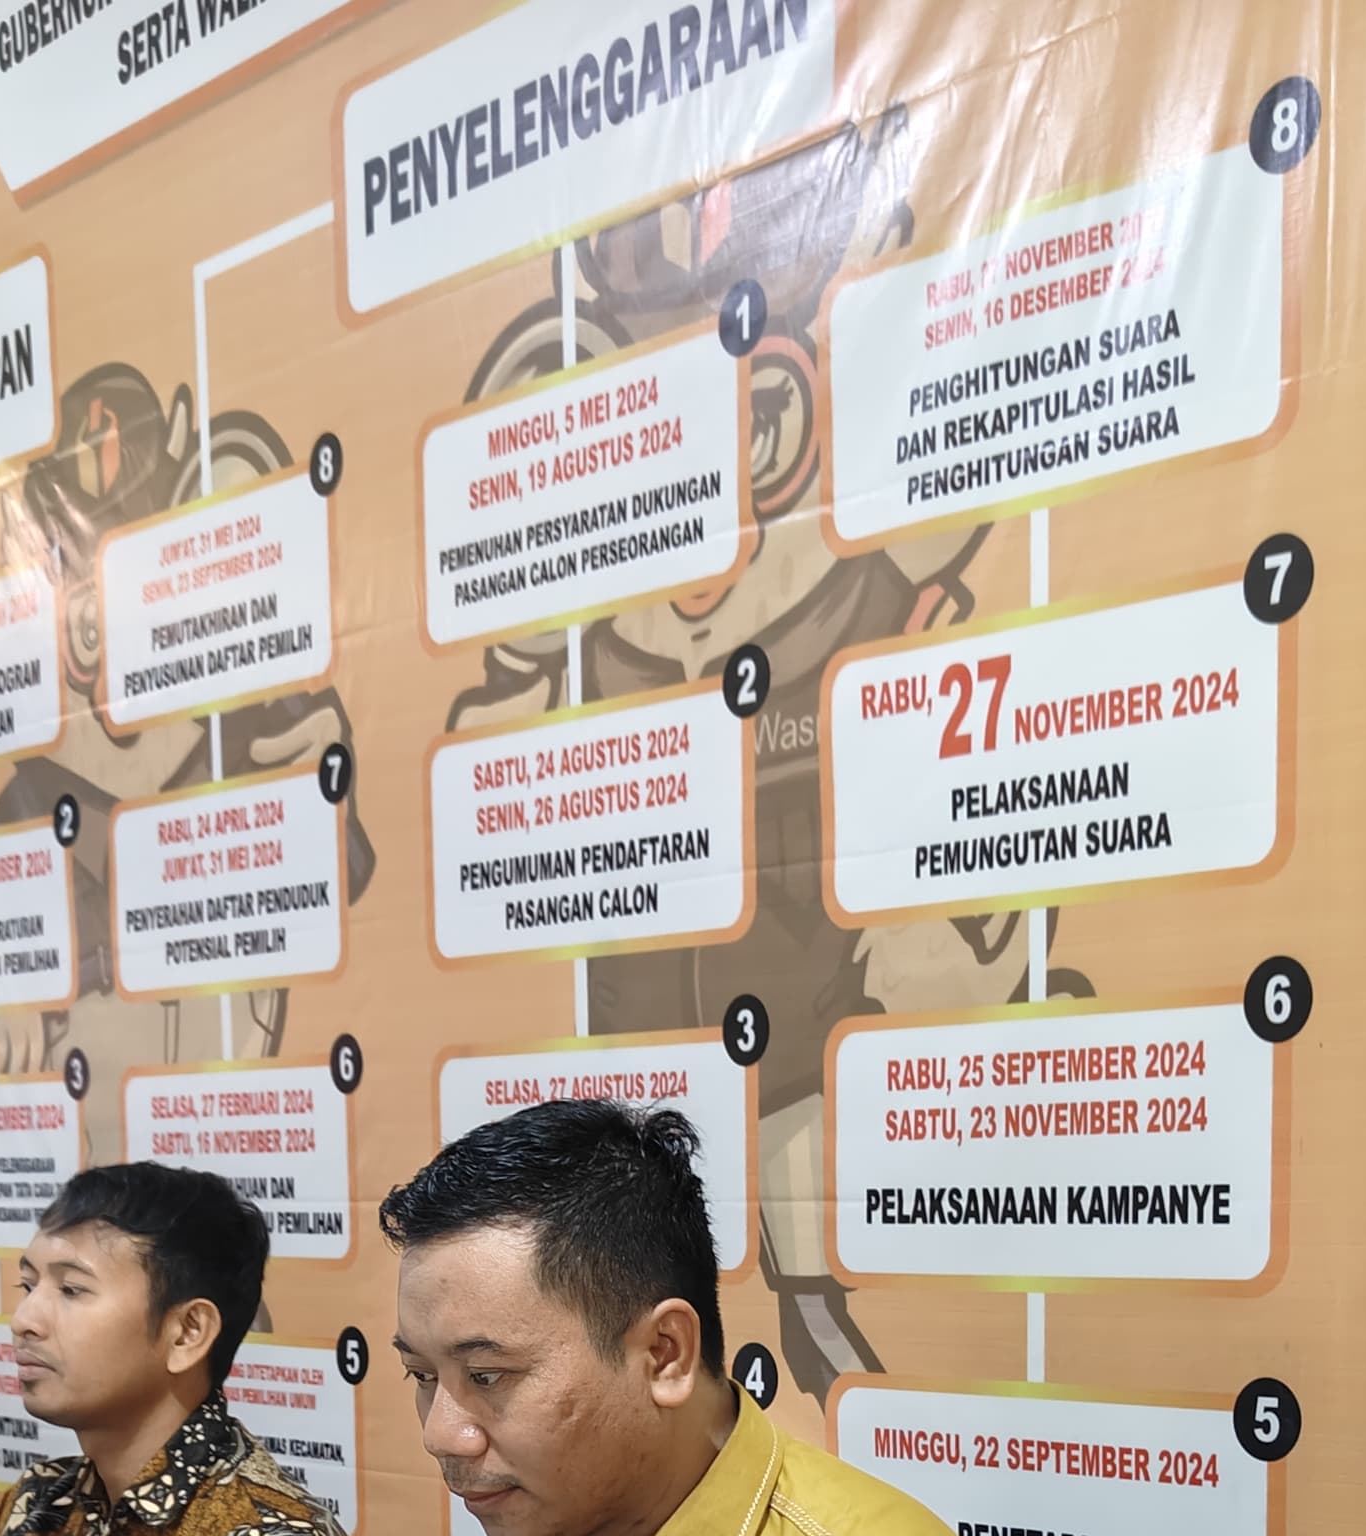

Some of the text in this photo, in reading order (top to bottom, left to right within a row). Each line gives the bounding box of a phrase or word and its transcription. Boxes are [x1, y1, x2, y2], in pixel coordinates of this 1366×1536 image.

[118, 0, 191, 85] SERTA
[364, 0, 808, 237] PENYELENGGARAAN
[1271, 97, 1298, 153] 8
[1006, 222, 1113, 280] NOVEMBER
[736, 295, 751, 340] 1
[925, 309, 977, 351] SENIN,
[984, 298, 1004, 329] 16
[1011, 265, 1113, 320] DESEMBER
[910, 309, 1181, 416] PENGHITUNGAN SUARA
[488, 376, 659, 459] MINGGU, 5 MEI 2024
[896, 353, 1196, 465] DAN REKAPITULASI HASIL
[317, 445, 335, 483] 8
[469, 416, 683, 511] SENIN, 19 AGUSTUS 2024
[907, 406, 1180, 505] PENGHITUNGAN SUARA
[237, 514, 262, 543] 2024
[439, 470, 722, 575] PEMENUHAN PERSYARATAN DUKUNGAN
[257, 541, 284, 570] 2024
[455, 517, 704, 608] PASANGAN CALON PERSEORANGAN
[1263, 551, 1294, 604] 7
[151, 593, 278, 652] PEMUTAKHIRAN DAN
[124, 623, 313, 699] PENYUSUNAN DAFTAR PEMILIH
[736, 658, 757, 706] 2
[860, 653, 1240, 760] RABU, 27 NOVEMBER 2024
[327, 755, 343, 792] 7
[473, 723, 690, 792] SABTU, 24 AGUSTUS 2024
[476, 772, 689, 836] SENIN, 26 AGUSTUS 2024
[951, 761, 1129, 821] PELAKSANAAN
[59, 804, 74, 838] 2
[157, 800, 284, 846] RABU, 24 APRIL 2024
[915, 812, 1172, 879] PEMUNGUTAN SUARA
[227, 840, 283, 872] MEI 2024
[460, 828, 710, 892] PENGUMUMAN PENDAFTARAN
[126, 881, 330, 934] PENYERAHAN DAFTAR PENDUDUK
[505, 883, 658, 931] PASANGAN CALON
[165, 927, 287, 966] POTENSIAL PEMILIH
[1264, 973, 1292, 1025] 6
[736, 1008, 756, 1053] 3
[70, 1058, 84, 1091] 3
[339, 1046, 354, 1083] 6
[550, 1076, 566, 1100] 27
[572, 1072, 645, 1101] AGUSTUS
[650, 1070, 689, 1099] 2024
[887, 1040, 1206, 1096] RABU, 25 SEPTEMBER 2024
[151, 1089, 314, 1125] SELASA, FEBRUARI 2024
[885, 1096, 1208, 1147] SABTU, 23 NOVEMBER 2024
[152, 1128, 316, 1158] SABTU, NOVEMBER 2024
[270, 1177, 295, 1199] DAN
[866, 1184, 1231, 1225] PELAKSANAAN KAMPANYE
[278, 1211, 343, 1234] PEMILIHAN
[346, 1339, 359, 1375] 5
[745, 1357, 765, 1400] 4
[1253, 1396, 1281, 1443] 5
[874, 1427, 1219, 1488] MINGGU, 22 SEPTEMBER 2024
